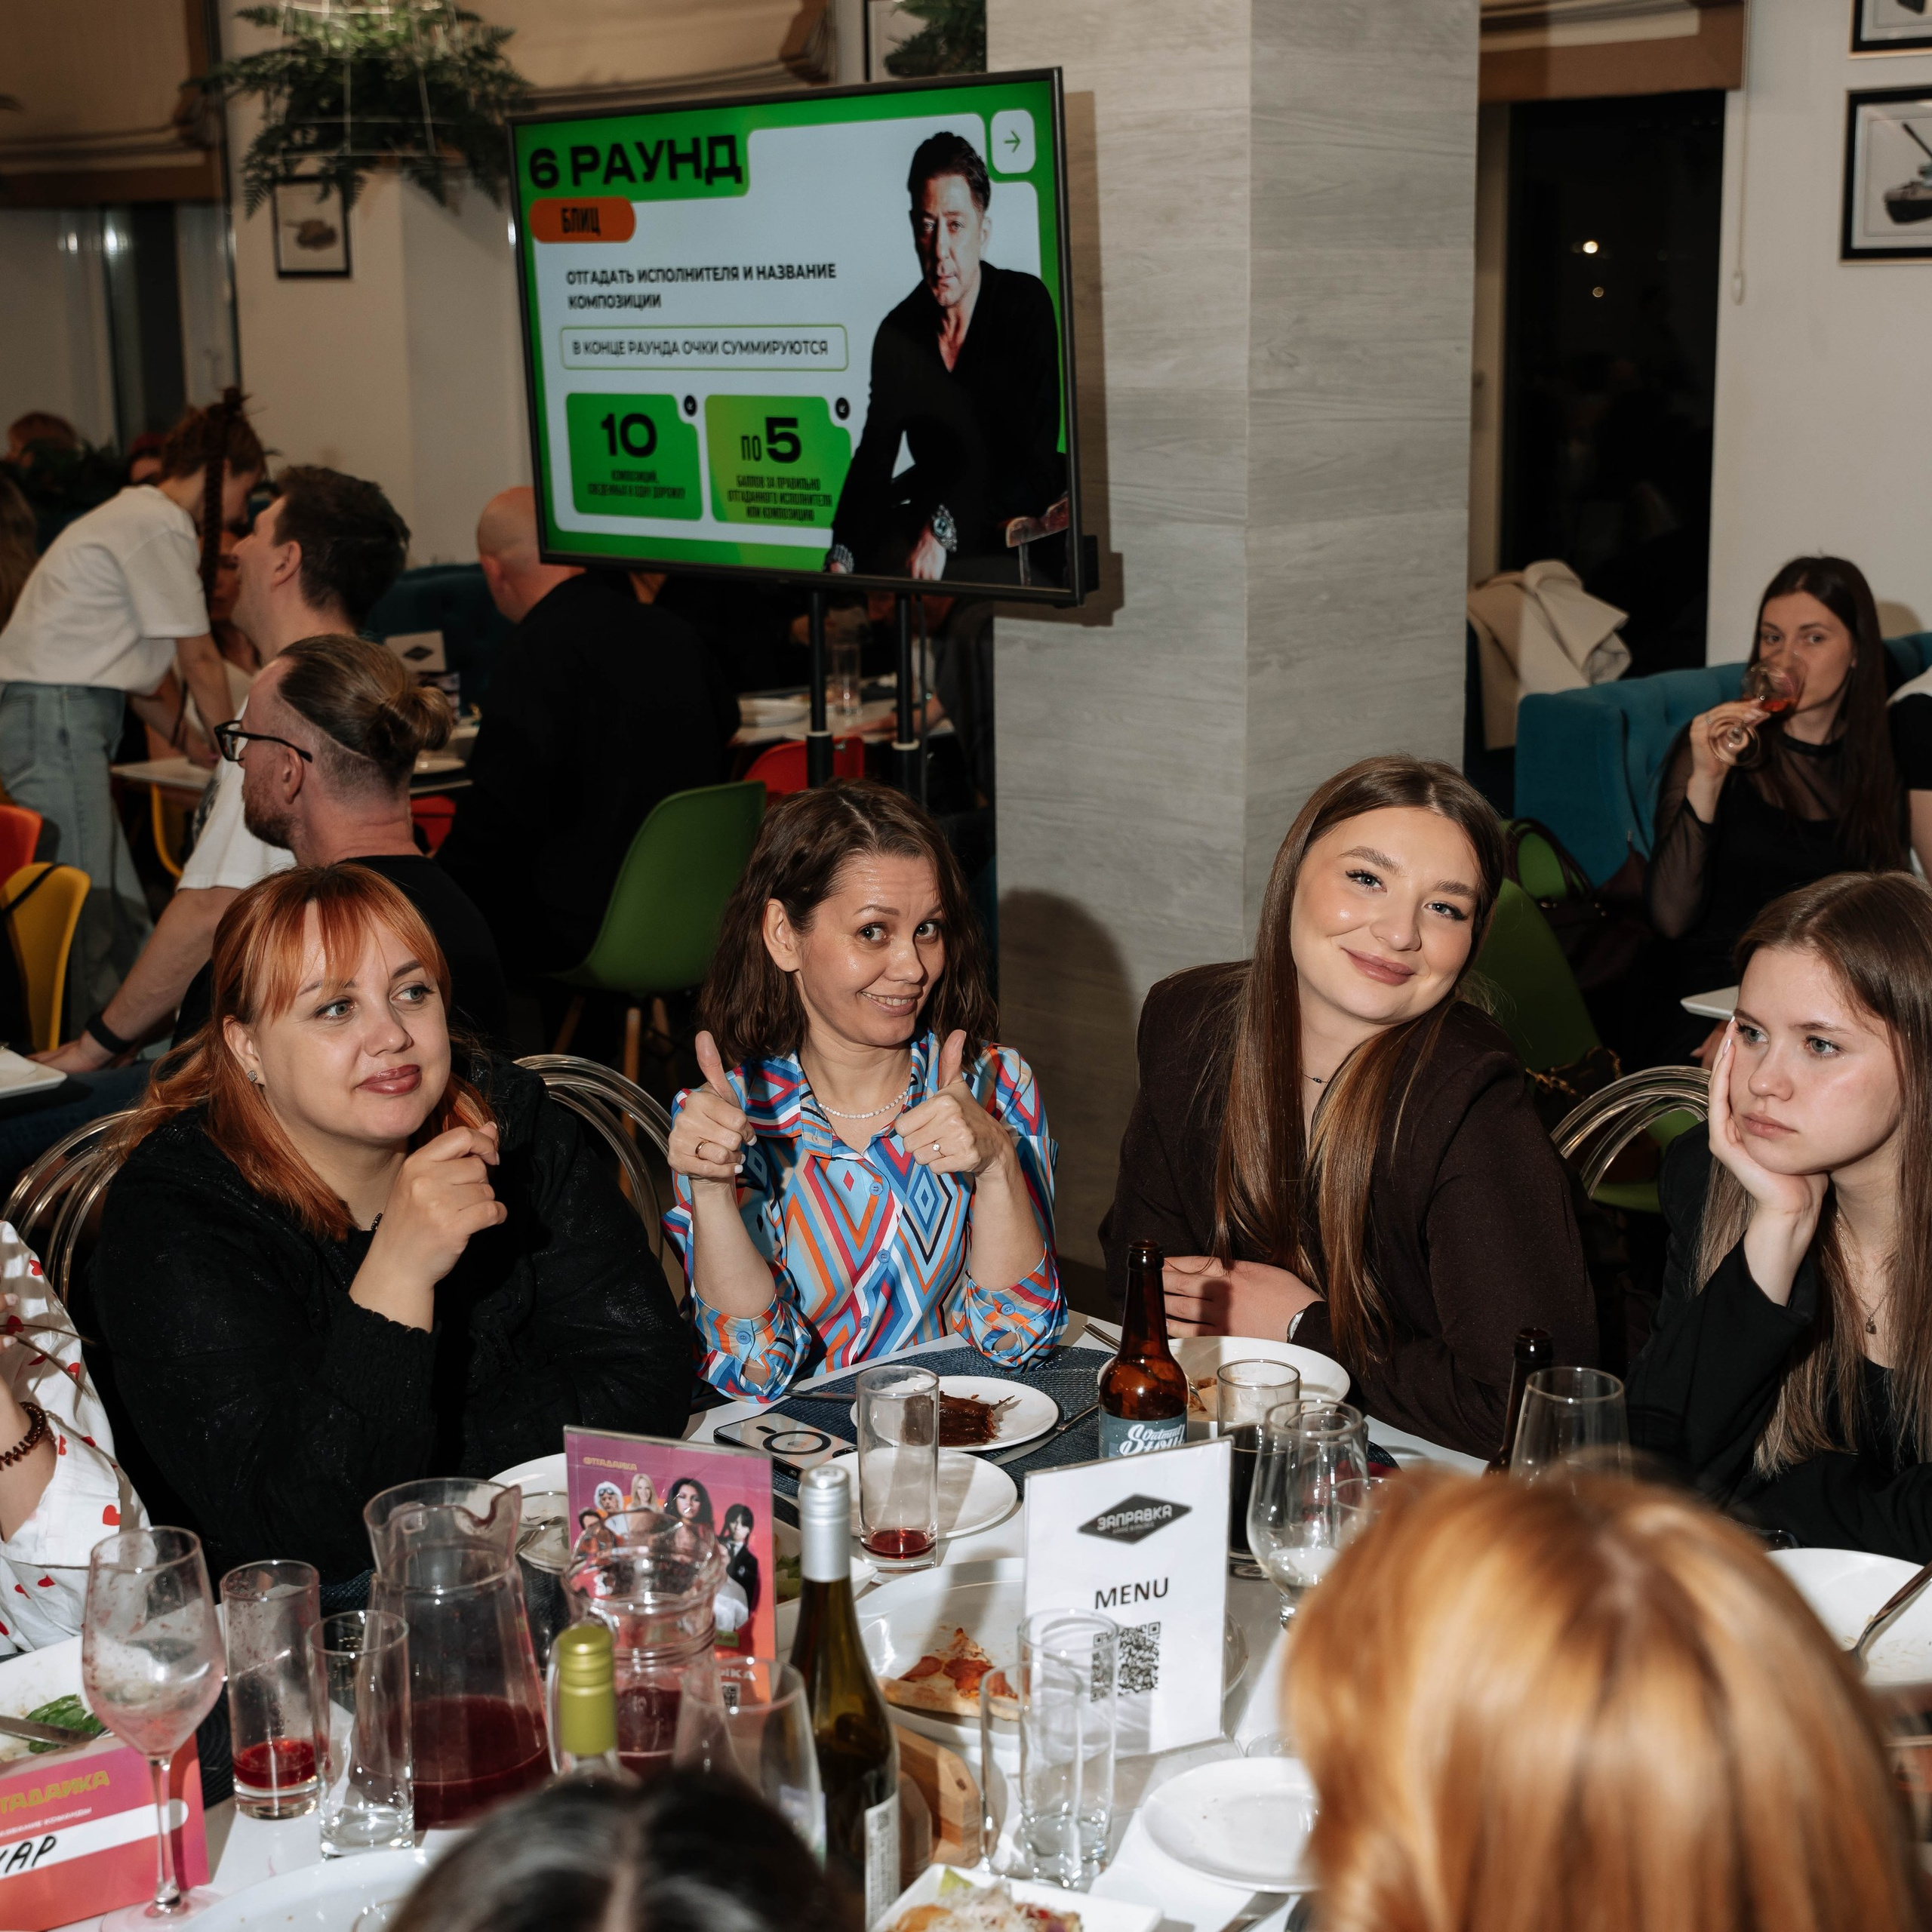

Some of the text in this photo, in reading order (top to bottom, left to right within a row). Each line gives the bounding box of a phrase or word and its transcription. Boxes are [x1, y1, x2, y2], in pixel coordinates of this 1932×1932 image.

[530, 134, 743, 189] 6 РАУНД
[561, 207, 601, 235] БЛИЦ
[568, 263, 837, 287] ОТГАДАТЬ ИСПОЛНИТЕЛЯ И НАЗВАНИЕ
[568, 294, 661, 310] КОМПОЗИЦИИ
[573, 340, 828, 357] В КОНЦЕ РАУНДА ОЧКИ СУММИРУЮТСЯ
[601, 413, 657, 457] 10
[741, 417, 801, 463] ПО 5
[1097, 1504, 1173, 1531] ЗАПРАВКА
[1095, 1577, 1168, 1609] MENU
